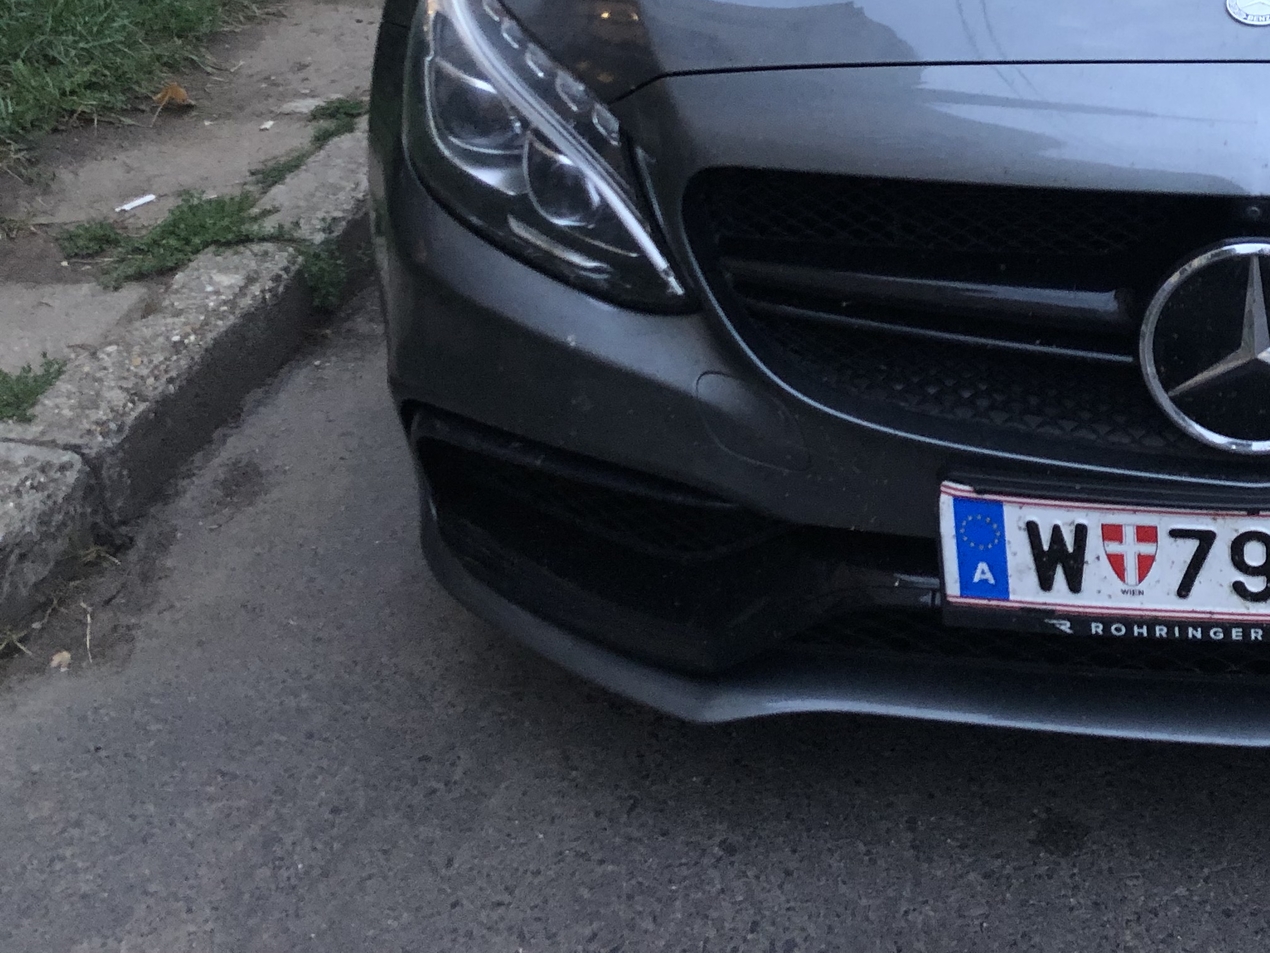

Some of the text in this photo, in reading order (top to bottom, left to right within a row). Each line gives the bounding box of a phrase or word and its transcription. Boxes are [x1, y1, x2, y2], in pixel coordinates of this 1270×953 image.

[1026, 519, 1088, 594] W
[972, 561, 996, 585] A
[1121, 588, 1145, 596] WIEN
[1091, 621, 1263, 641] ROHRINGER
